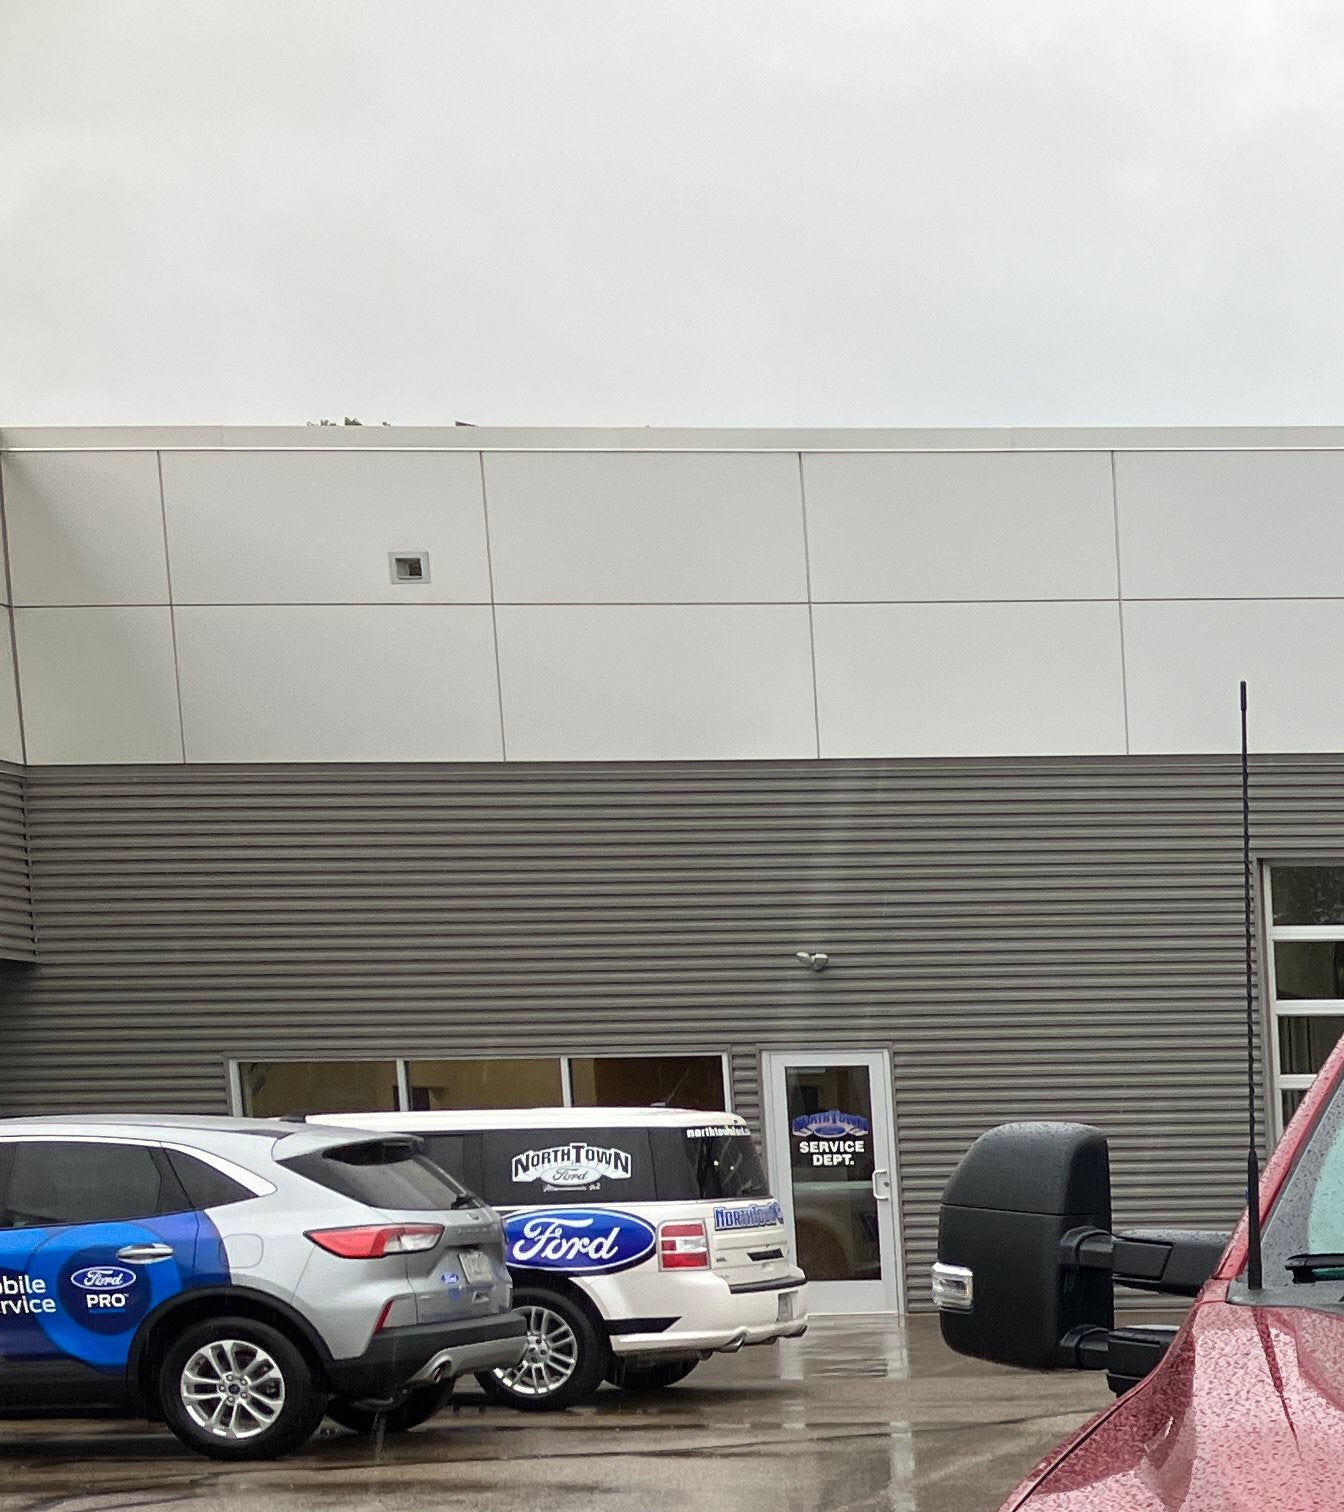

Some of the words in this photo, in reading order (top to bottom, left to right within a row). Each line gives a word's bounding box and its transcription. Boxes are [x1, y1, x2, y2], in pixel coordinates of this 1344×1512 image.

[799, 1140, 865, 1153] SERVICE
[513, 1144, 630, 1179] NORTHTOWN
[812, 1154, 855, 1166] DEPT.
[552, 1168, 588, 1181] Ford
[512, 1217, 620, 1261] Ford
[0, 1274, 46, 1295] bile
[83, 1269, 124, 1286] Ford
[0, 1295, 57, 1315] rvice
